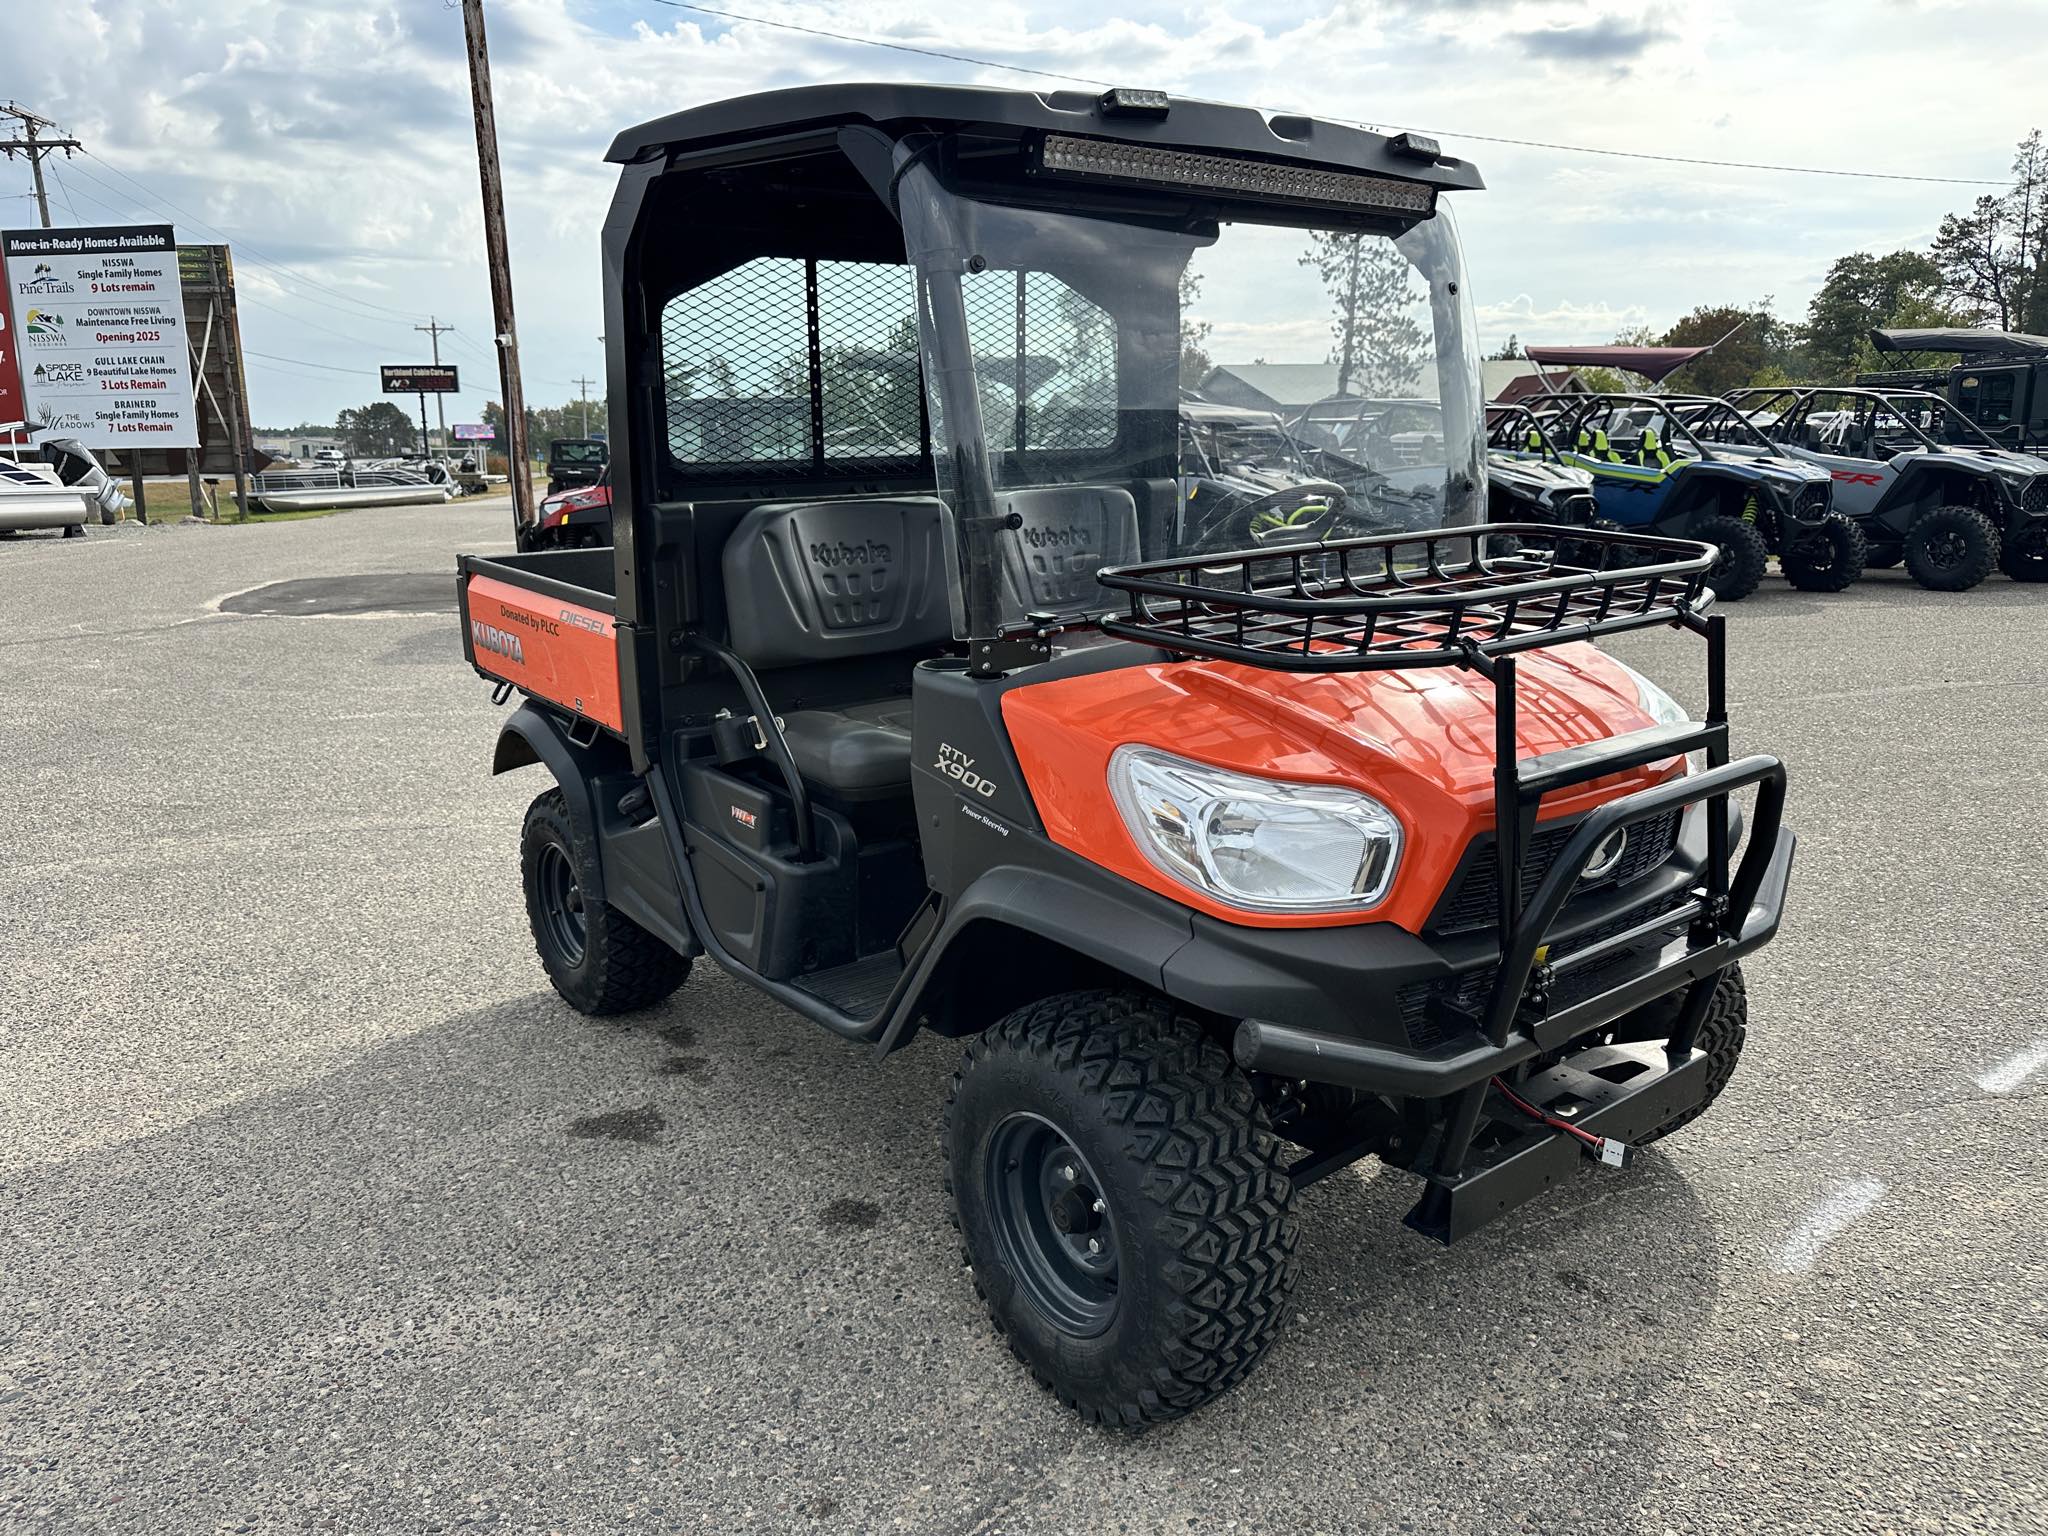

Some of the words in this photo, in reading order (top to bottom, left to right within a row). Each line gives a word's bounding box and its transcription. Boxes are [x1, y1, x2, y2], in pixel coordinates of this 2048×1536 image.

[11, 238, 82, 251] Move-in-Ready
[84, 237, 118, 248] Homes
[119, 235, 165, 246] Available
[102, 258, 134, 267] NISSWA
[78, 271, 103, 280] Single
[105, 270, 132, 279] Family
[134, 269, 162, 277] Homes
[19, 282, 43, 294] Pine
[43, 282, 74, 293] Trails
[91, 283, 98, 293] 9
[101, 283, 120, 292] Lots
[122, 282, 155, 292] remain
[88, 308, 131, 316] DOWNTOWN
[76, 318, 129, 326] Maintenance
[131, 317, 149, 325] Free
[151, 316, 176, 326] Living
[28, 334, 66, 342] NISSWA
[96, 332, 134, 344] Opening
[137, 331, 160, 341] 2025
[95, 357, 115, 365] GULL
[118, 356, 138, 364] LAKE
[140, 356, 165, 364] CHAIN
[48, 372, 84, 381] LAKE
[93, 368, 129, 376] Beautiful
[151, 367, 176, 375] Homes
[102, 381, 107, 390] 3
[109, 380, 129, 389] Lots
[131, 379, 166, 389] Remain
[114, 400, 156, 409] BRAINERD
[95, 412, 120, 421] Single
[122, 411, 149, 420] Family
[151, 410, 179, 418] Homes
[108, 423, 113, 432] 7
[118, 422, 136, 432] Lots
[138, 422, 173, 431] Remain
[1023, 525, 1091, 548] Kubota
[810, 540, 892, 568] Kubota
[500, 605, 529, 626] Donated
[530, 614, 540, 632] by
[541, 618, 560, 636] PLCC
[560, 610, 608, 636] DIESEL
[472, 619, 525, 665] KUBOTA
[939, 742, 975, 768] RTV
[933, 754, 997, 798] X900
[962, 805, 982, 821] Power
[982, 816, 1010, 837] Steering
